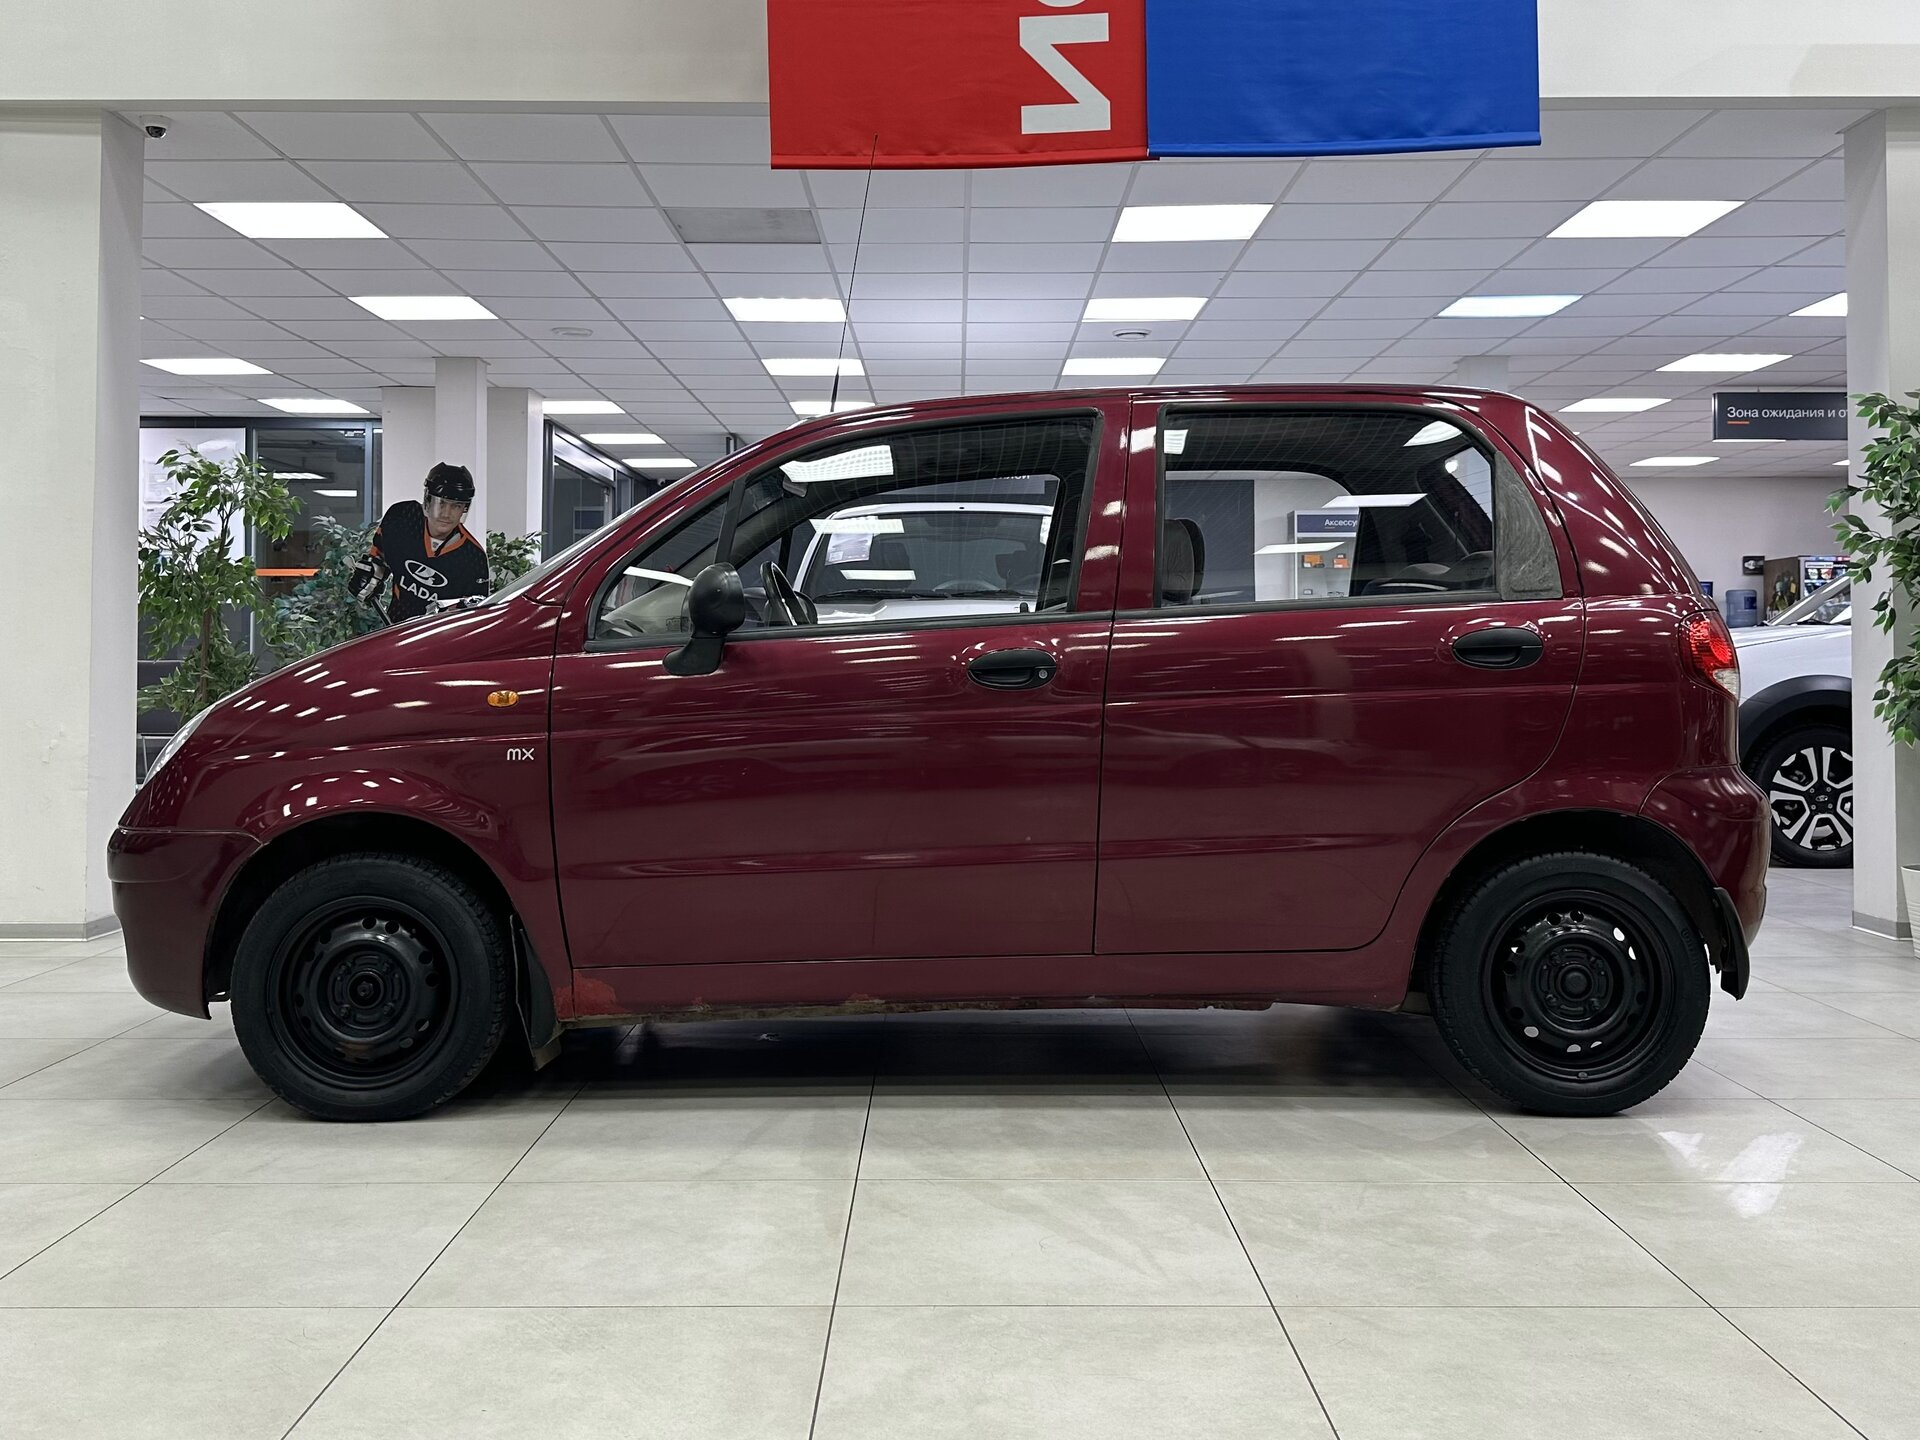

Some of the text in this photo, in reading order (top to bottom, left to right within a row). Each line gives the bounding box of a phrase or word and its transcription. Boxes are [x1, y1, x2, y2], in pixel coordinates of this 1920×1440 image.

[1727, 406, 1848, 419] Зона ожидания и о
[1324, 518, 1358, 527] Аксессу
[400, 575, 439, 602] LADA
